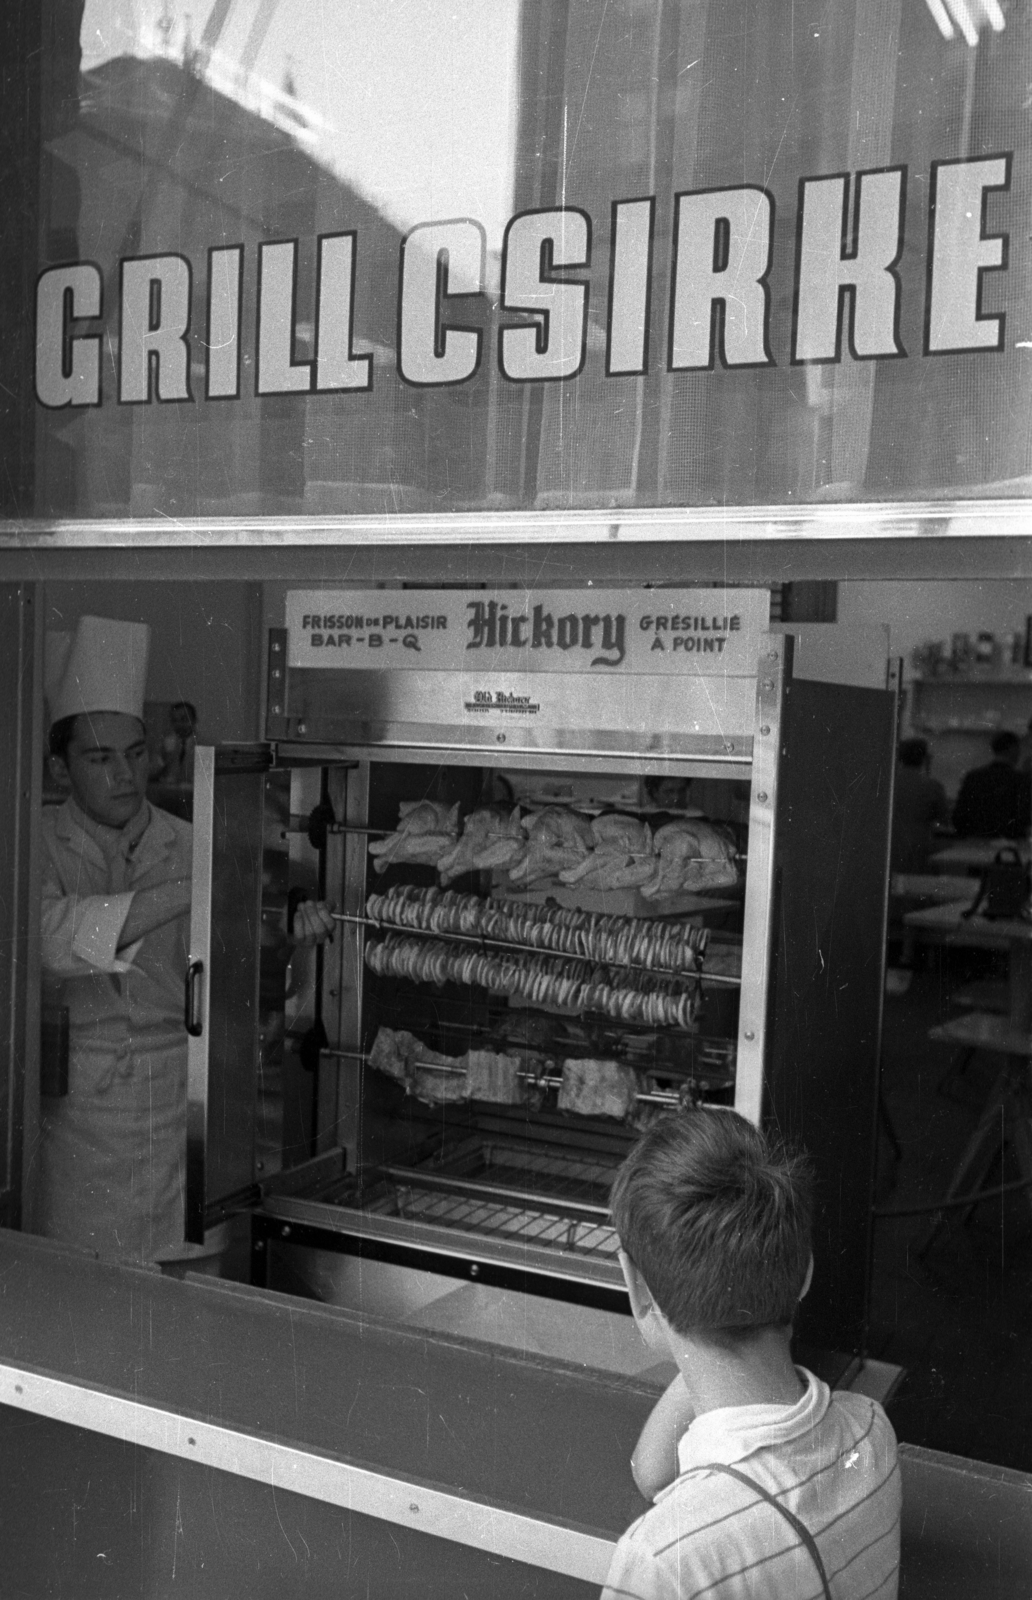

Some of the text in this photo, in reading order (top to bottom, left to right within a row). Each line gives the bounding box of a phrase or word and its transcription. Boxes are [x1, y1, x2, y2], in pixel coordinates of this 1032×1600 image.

[35, 152, 1012, 409] GRILL CSIRKE
[302, 614, 364, 630] FRISSON
[382, 614, 448, 630] PLAISIR
[466, 600, 626, 667] Hickory
[673, 636, 727, 652] POINT
